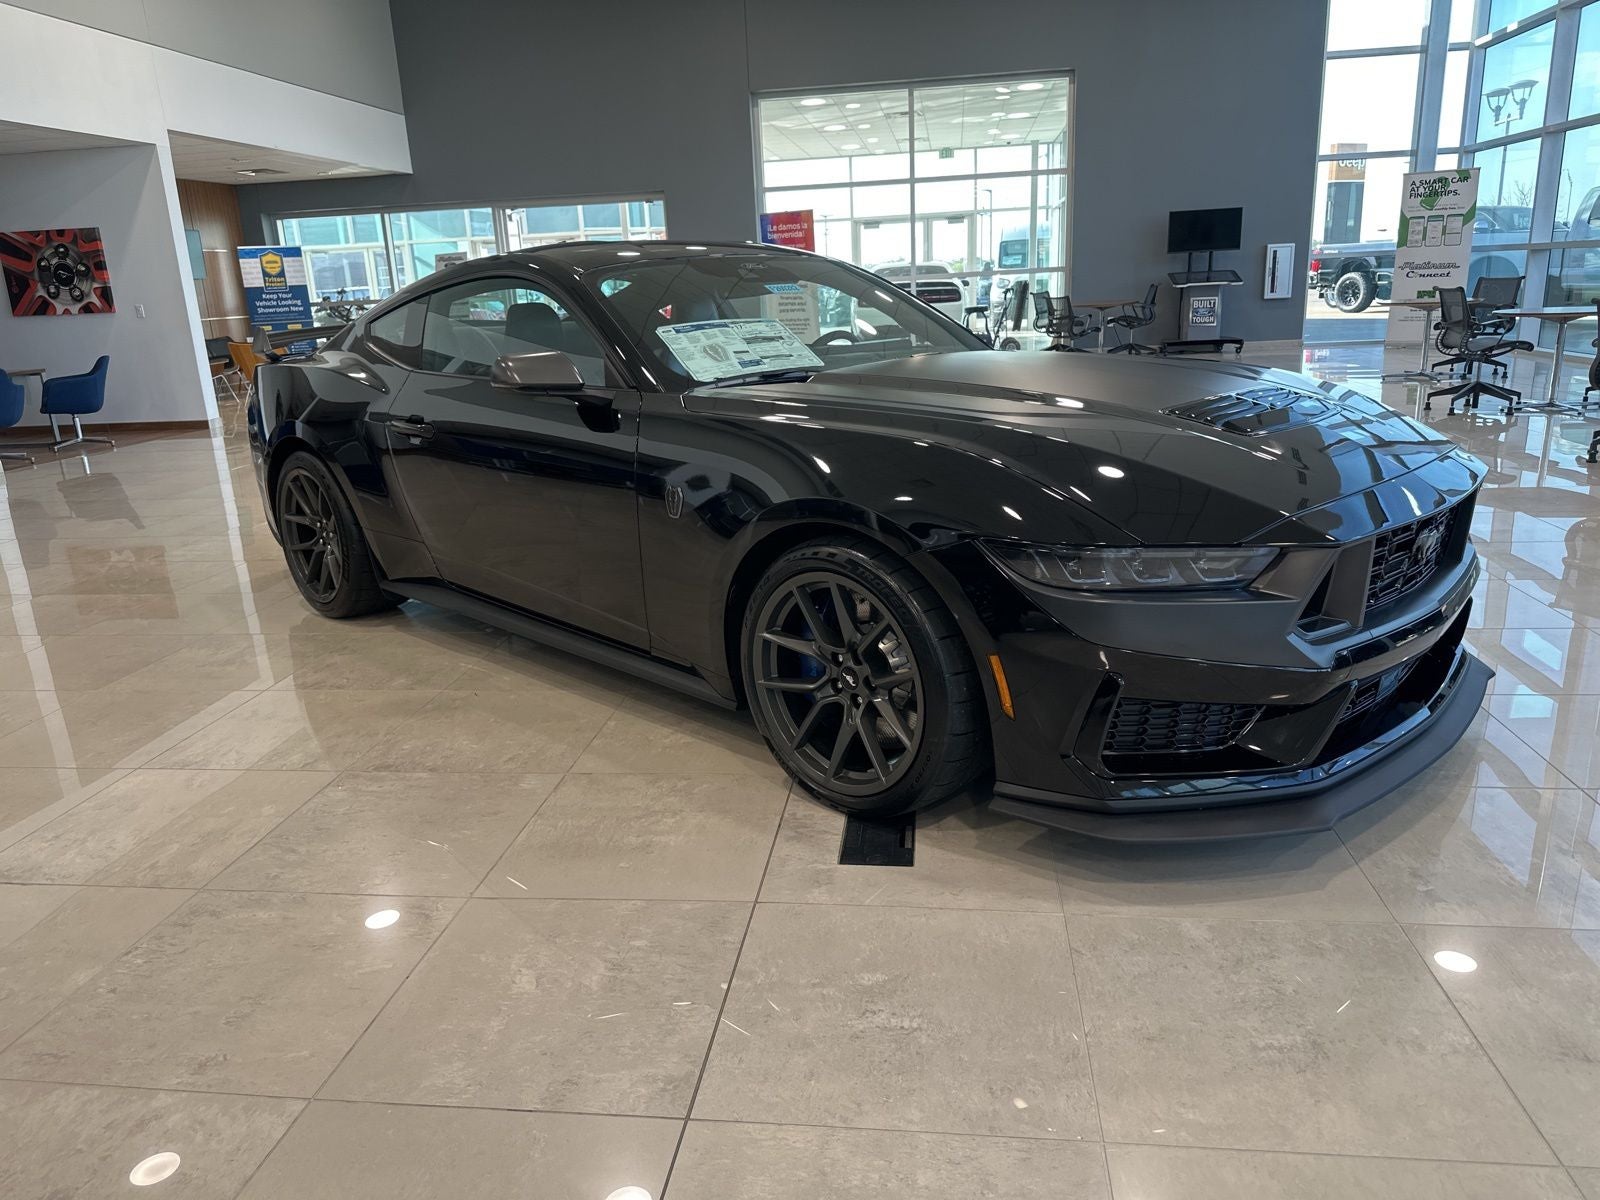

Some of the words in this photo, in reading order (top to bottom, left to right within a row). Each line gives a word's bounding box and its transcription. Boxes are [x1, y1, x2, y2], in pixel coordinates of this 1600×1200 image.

[1418, 177, 1449, 187] SMART
[1451, 176, 1469, 184] CAR
[1422, 184, 1447, 192] YOUR
[1409, 189, 1460, 199] FINGERTIPS.
[778, 223, 801, 231] damos
[767, 230, 806, 240] bienvenida!
[1193, 300, 1215, 308] BUILT
